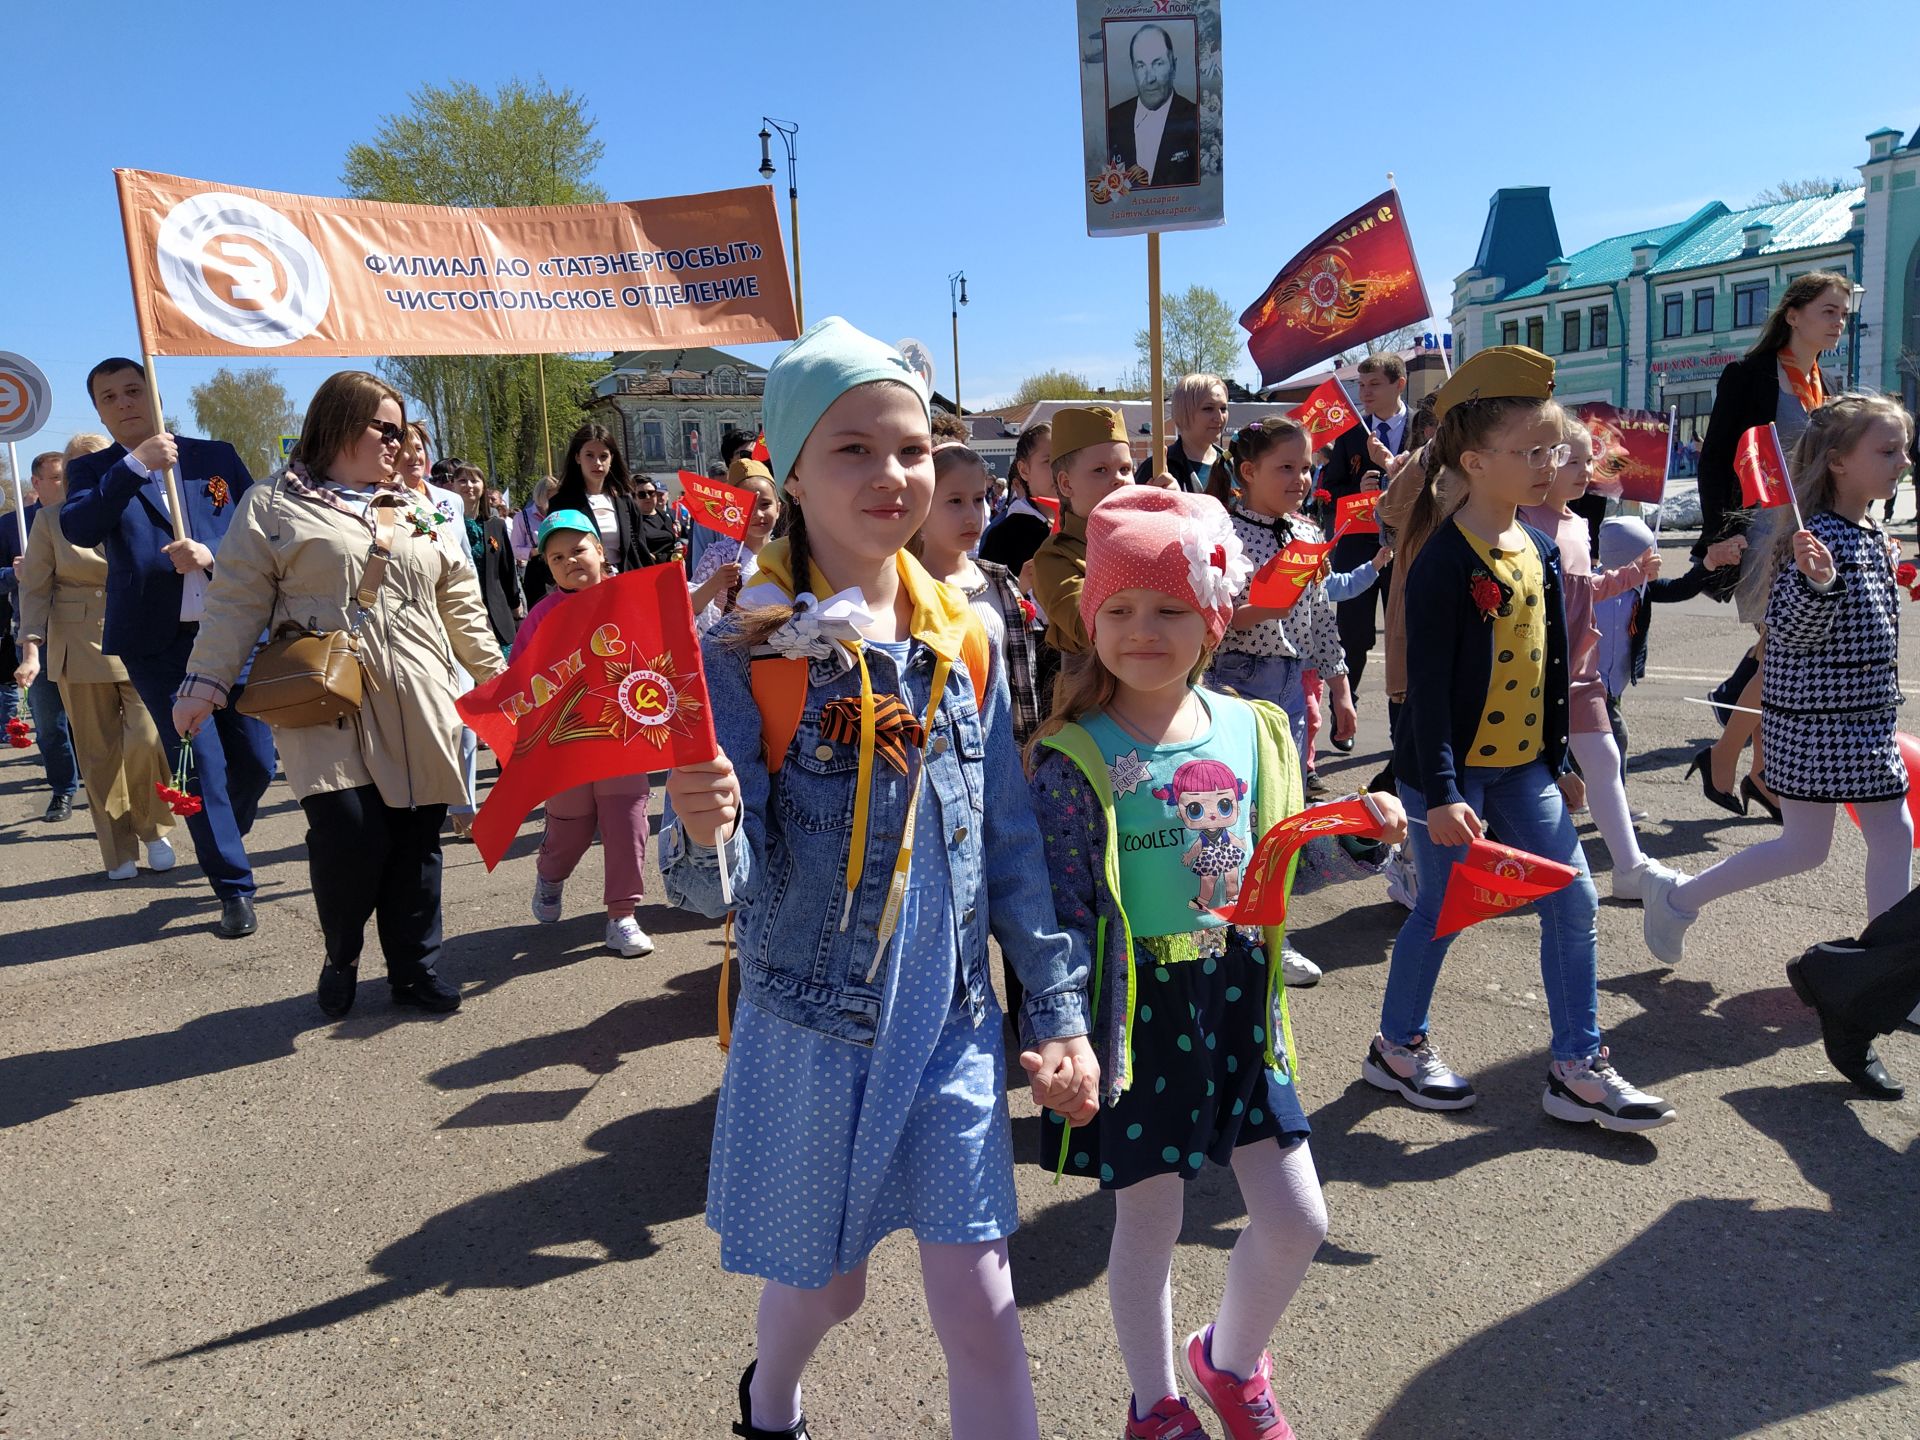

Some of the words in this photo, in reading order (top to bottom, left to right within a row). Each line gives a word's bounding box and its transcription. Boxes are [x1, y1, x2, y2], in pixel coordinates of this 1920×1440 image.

[365, 253, 488, 277] ФИЛИАЛ
[495, 257, 531, 277] АО
[538, 242, 763, 277] «ТАТЭНЕРГОСБЫТ»
[386, 288, 616, 311] ЧИСТОПОЛЬСКОЕ
[621, 276, 760, 308] ОТДЕЛЕНИЕ
[1124, 827, 1186, 851] COOLEST
